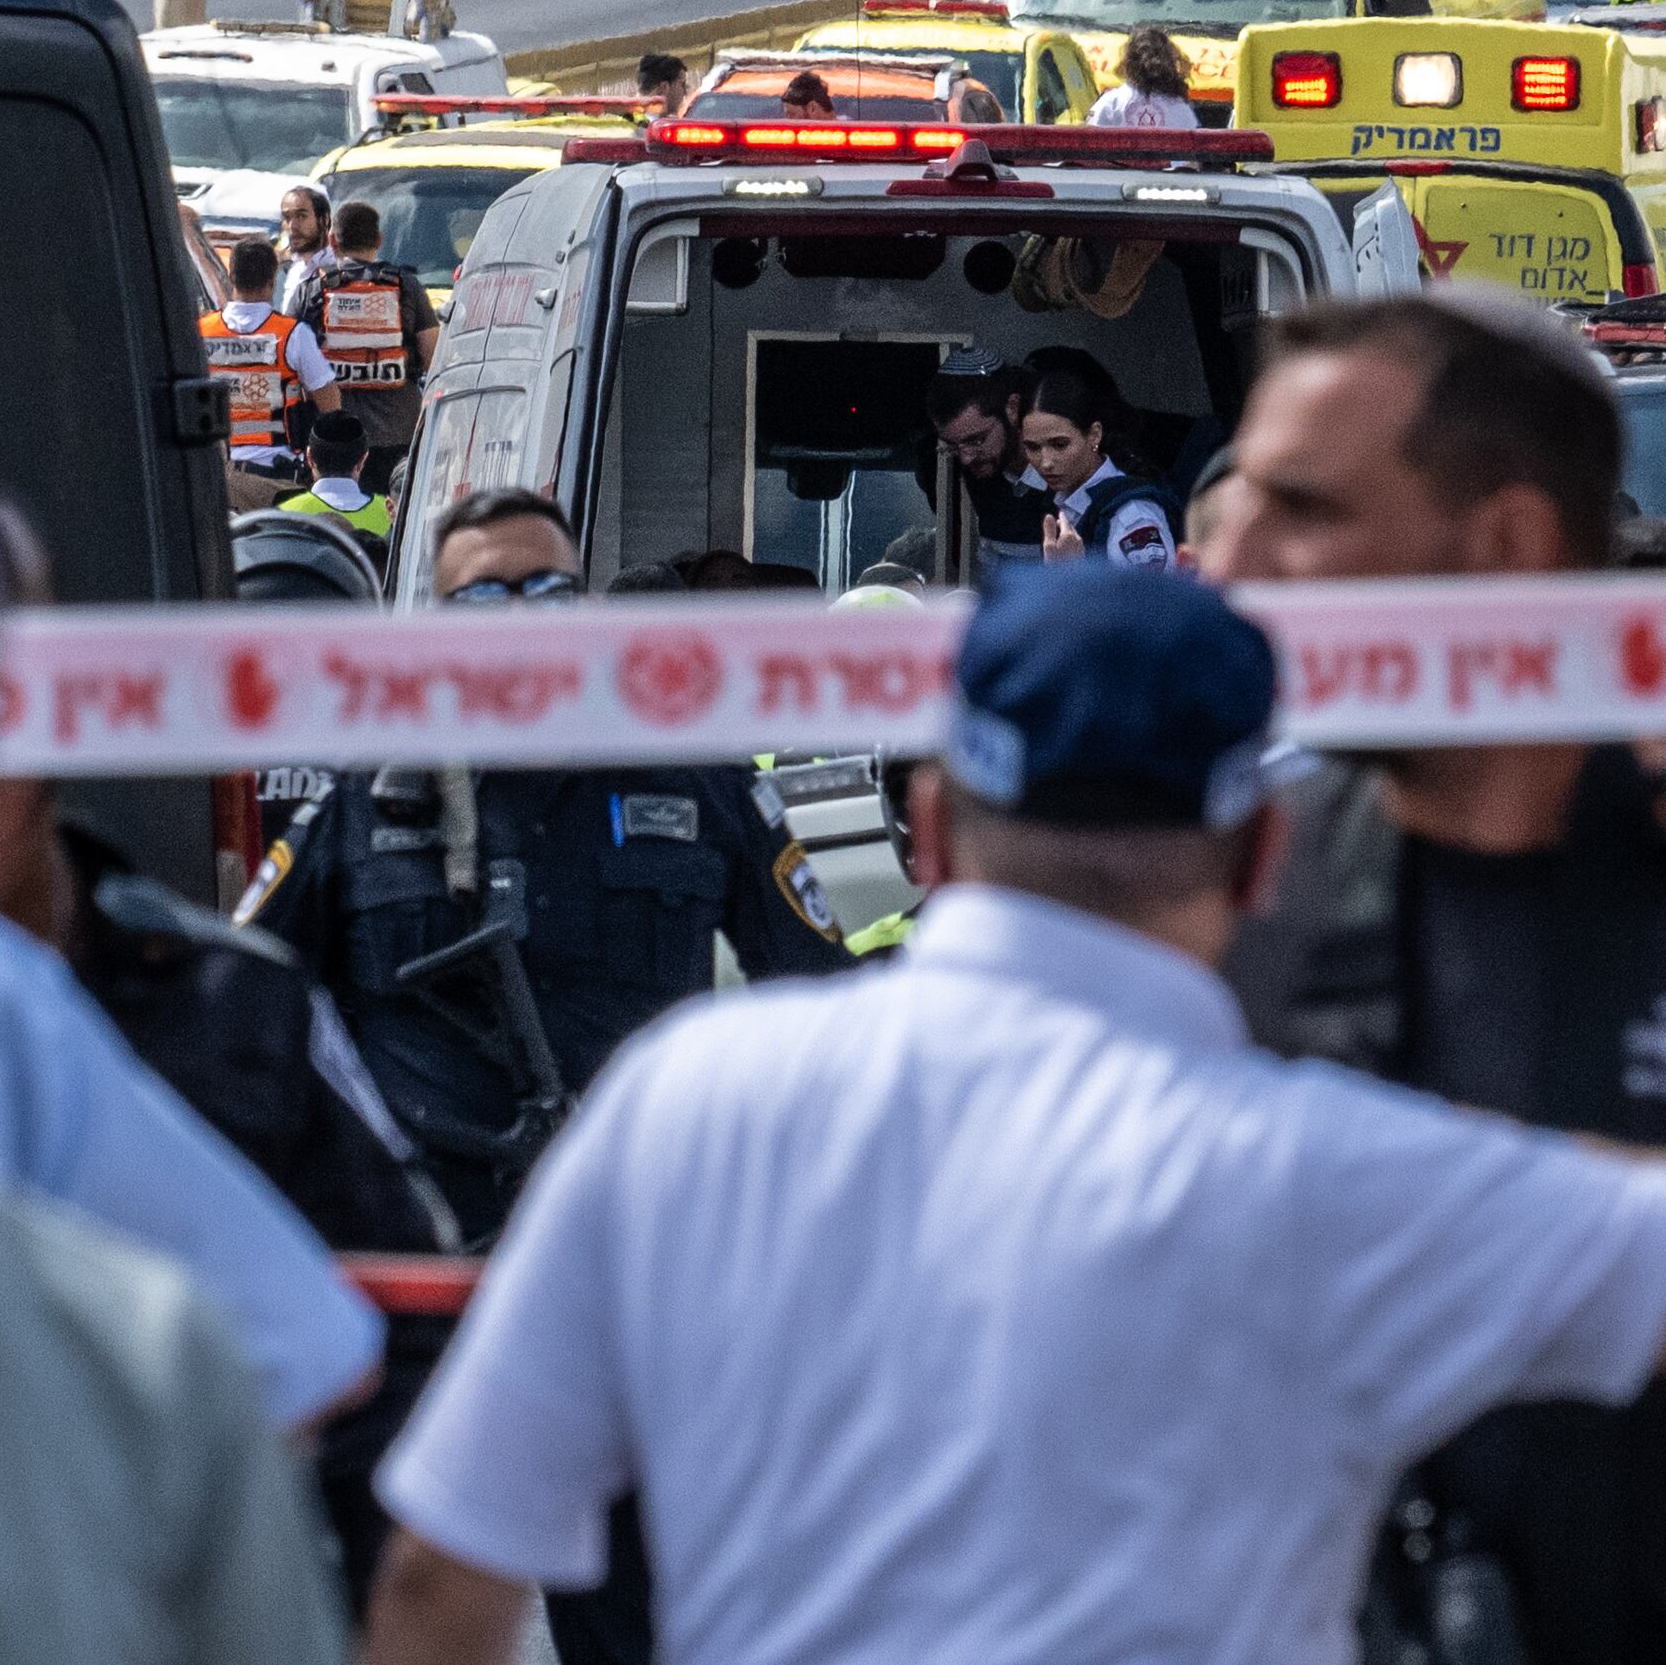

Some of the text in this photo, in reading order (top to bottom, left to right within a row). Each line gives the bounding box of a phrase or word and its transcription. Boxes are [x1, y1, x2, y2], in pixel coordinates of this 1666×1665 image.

[1488, 233, 1592, 266] מגן דוד
[1520, 266, 1588, 291] אדום
[54, 670, 167, 744] אין
[321, 645, 583, 725] ישראל
[1446, 640, 1559, 713] אין
